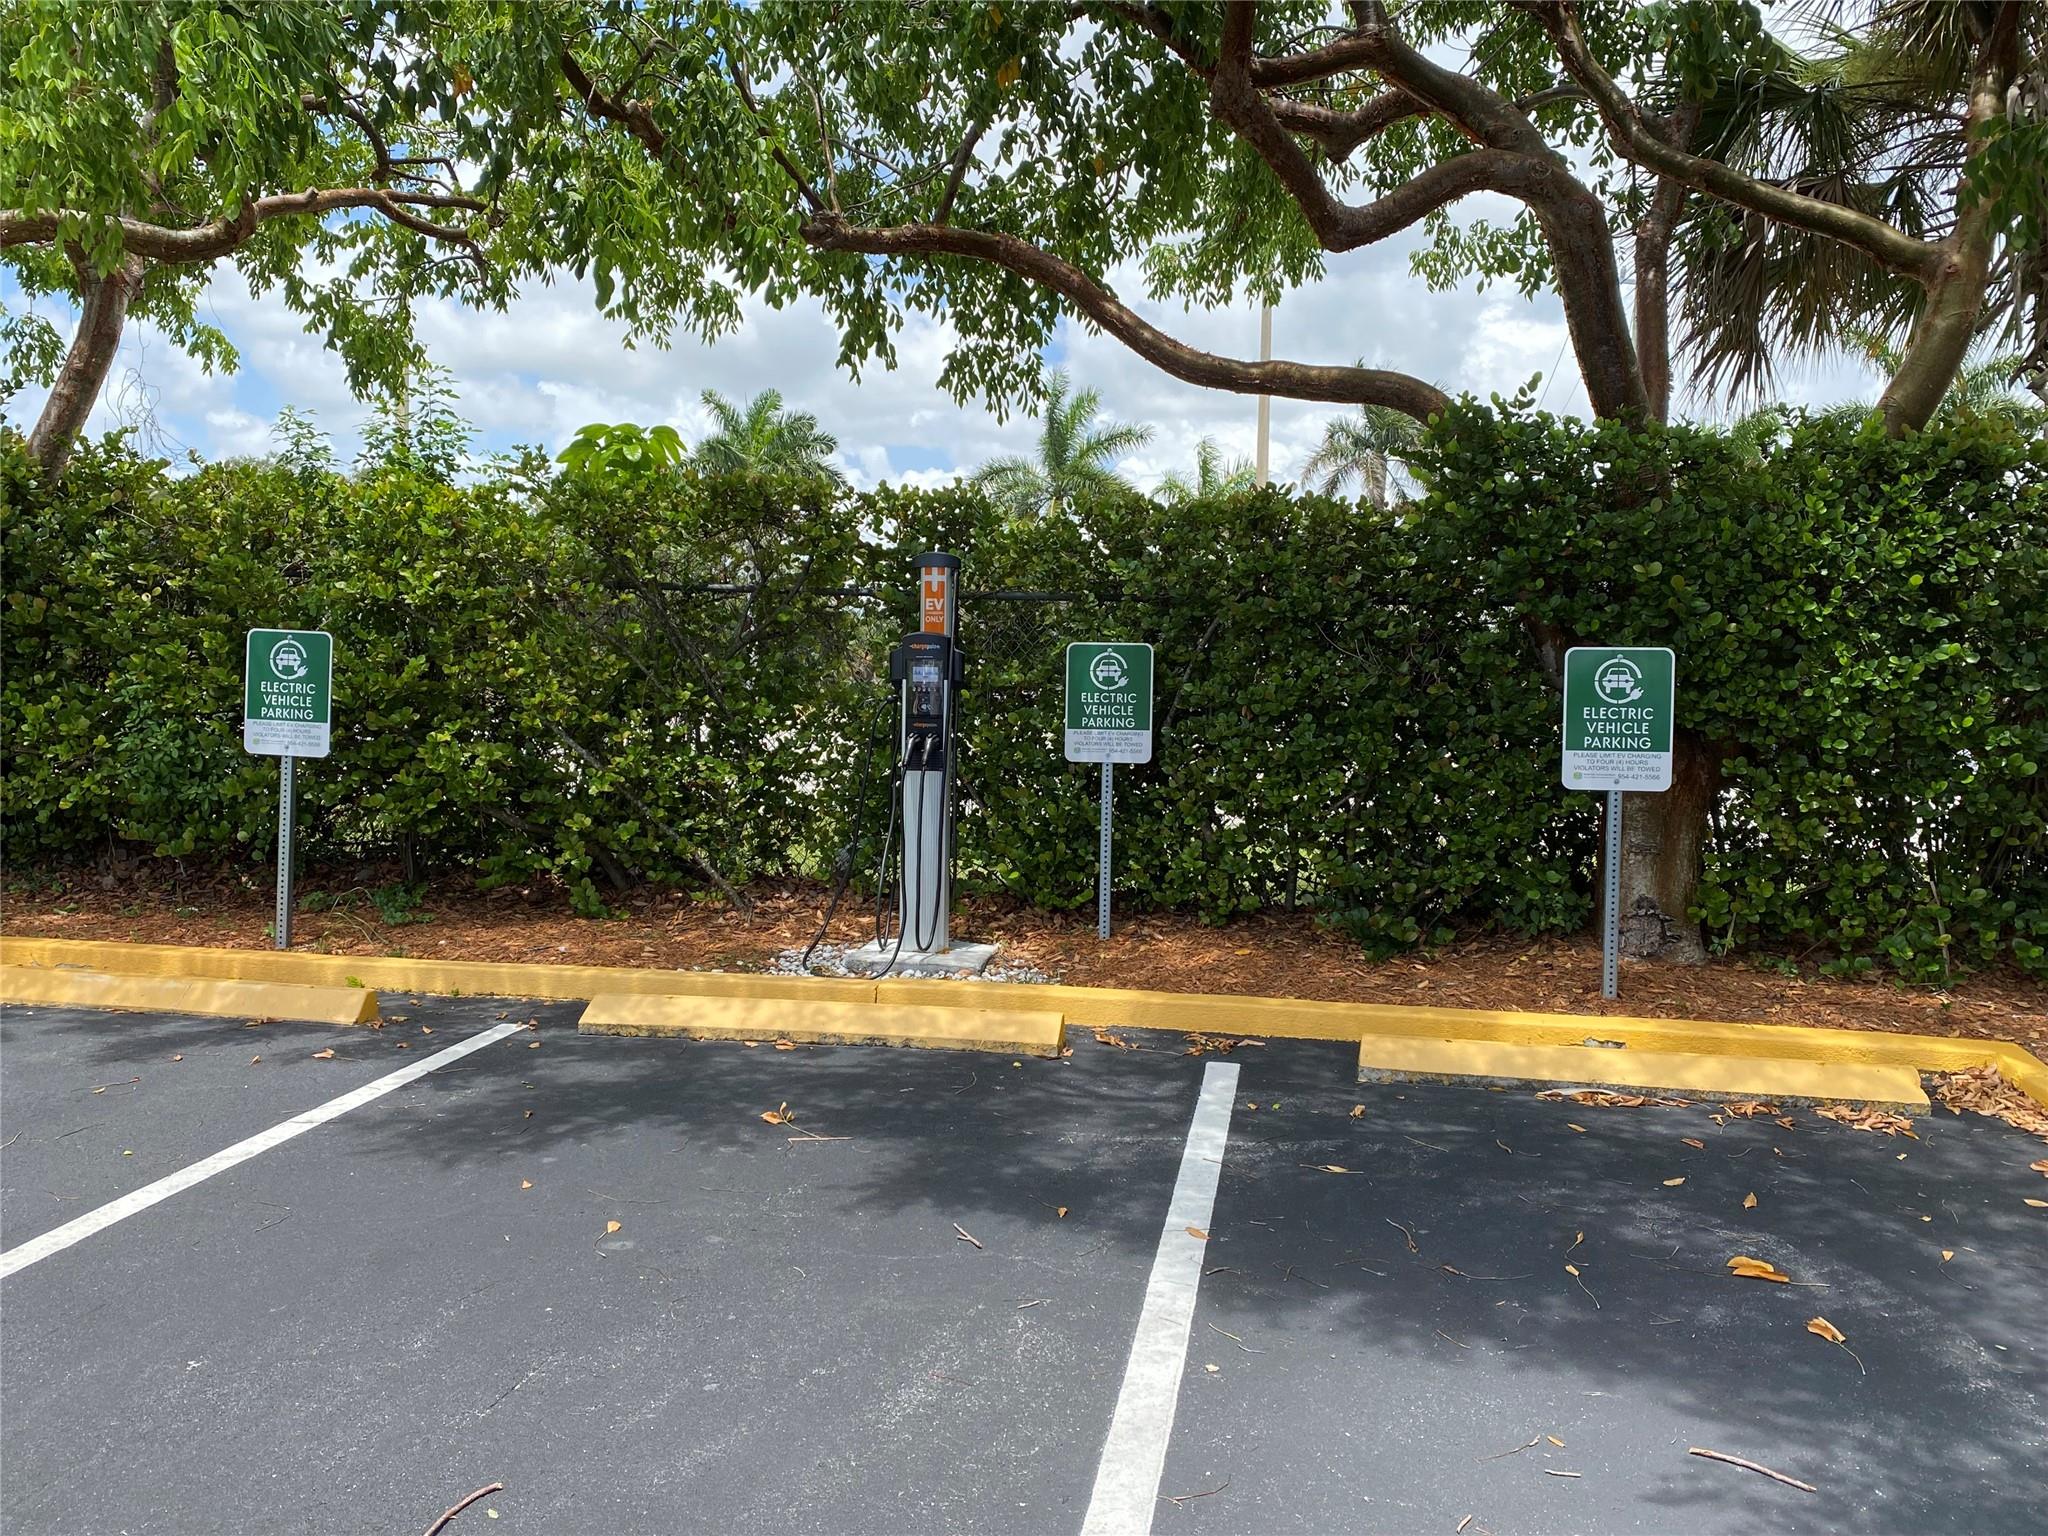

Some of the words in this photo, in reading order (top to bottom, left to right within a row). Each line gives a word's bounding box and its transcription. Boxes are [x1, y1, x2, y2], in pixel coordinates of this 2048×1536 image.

[926, 598, 944, 610] EV
[261, 681, 316, 693] ELECTRIC
[263, 695, 312, 706] VEHICLE
[1081, 693, 1136, 703] ELECTRIC
[261, 708, 313, 719] PARKING
[1084, 705, 1133, 715] VEHICLE
[1584, 707, 1653, 719] ELECTRIC
[1082, 718, 1135, 727] PARKING
[1586, 722, 1649, 734] VEHICLE
[1584, 737, 1651, 748] PARKING
